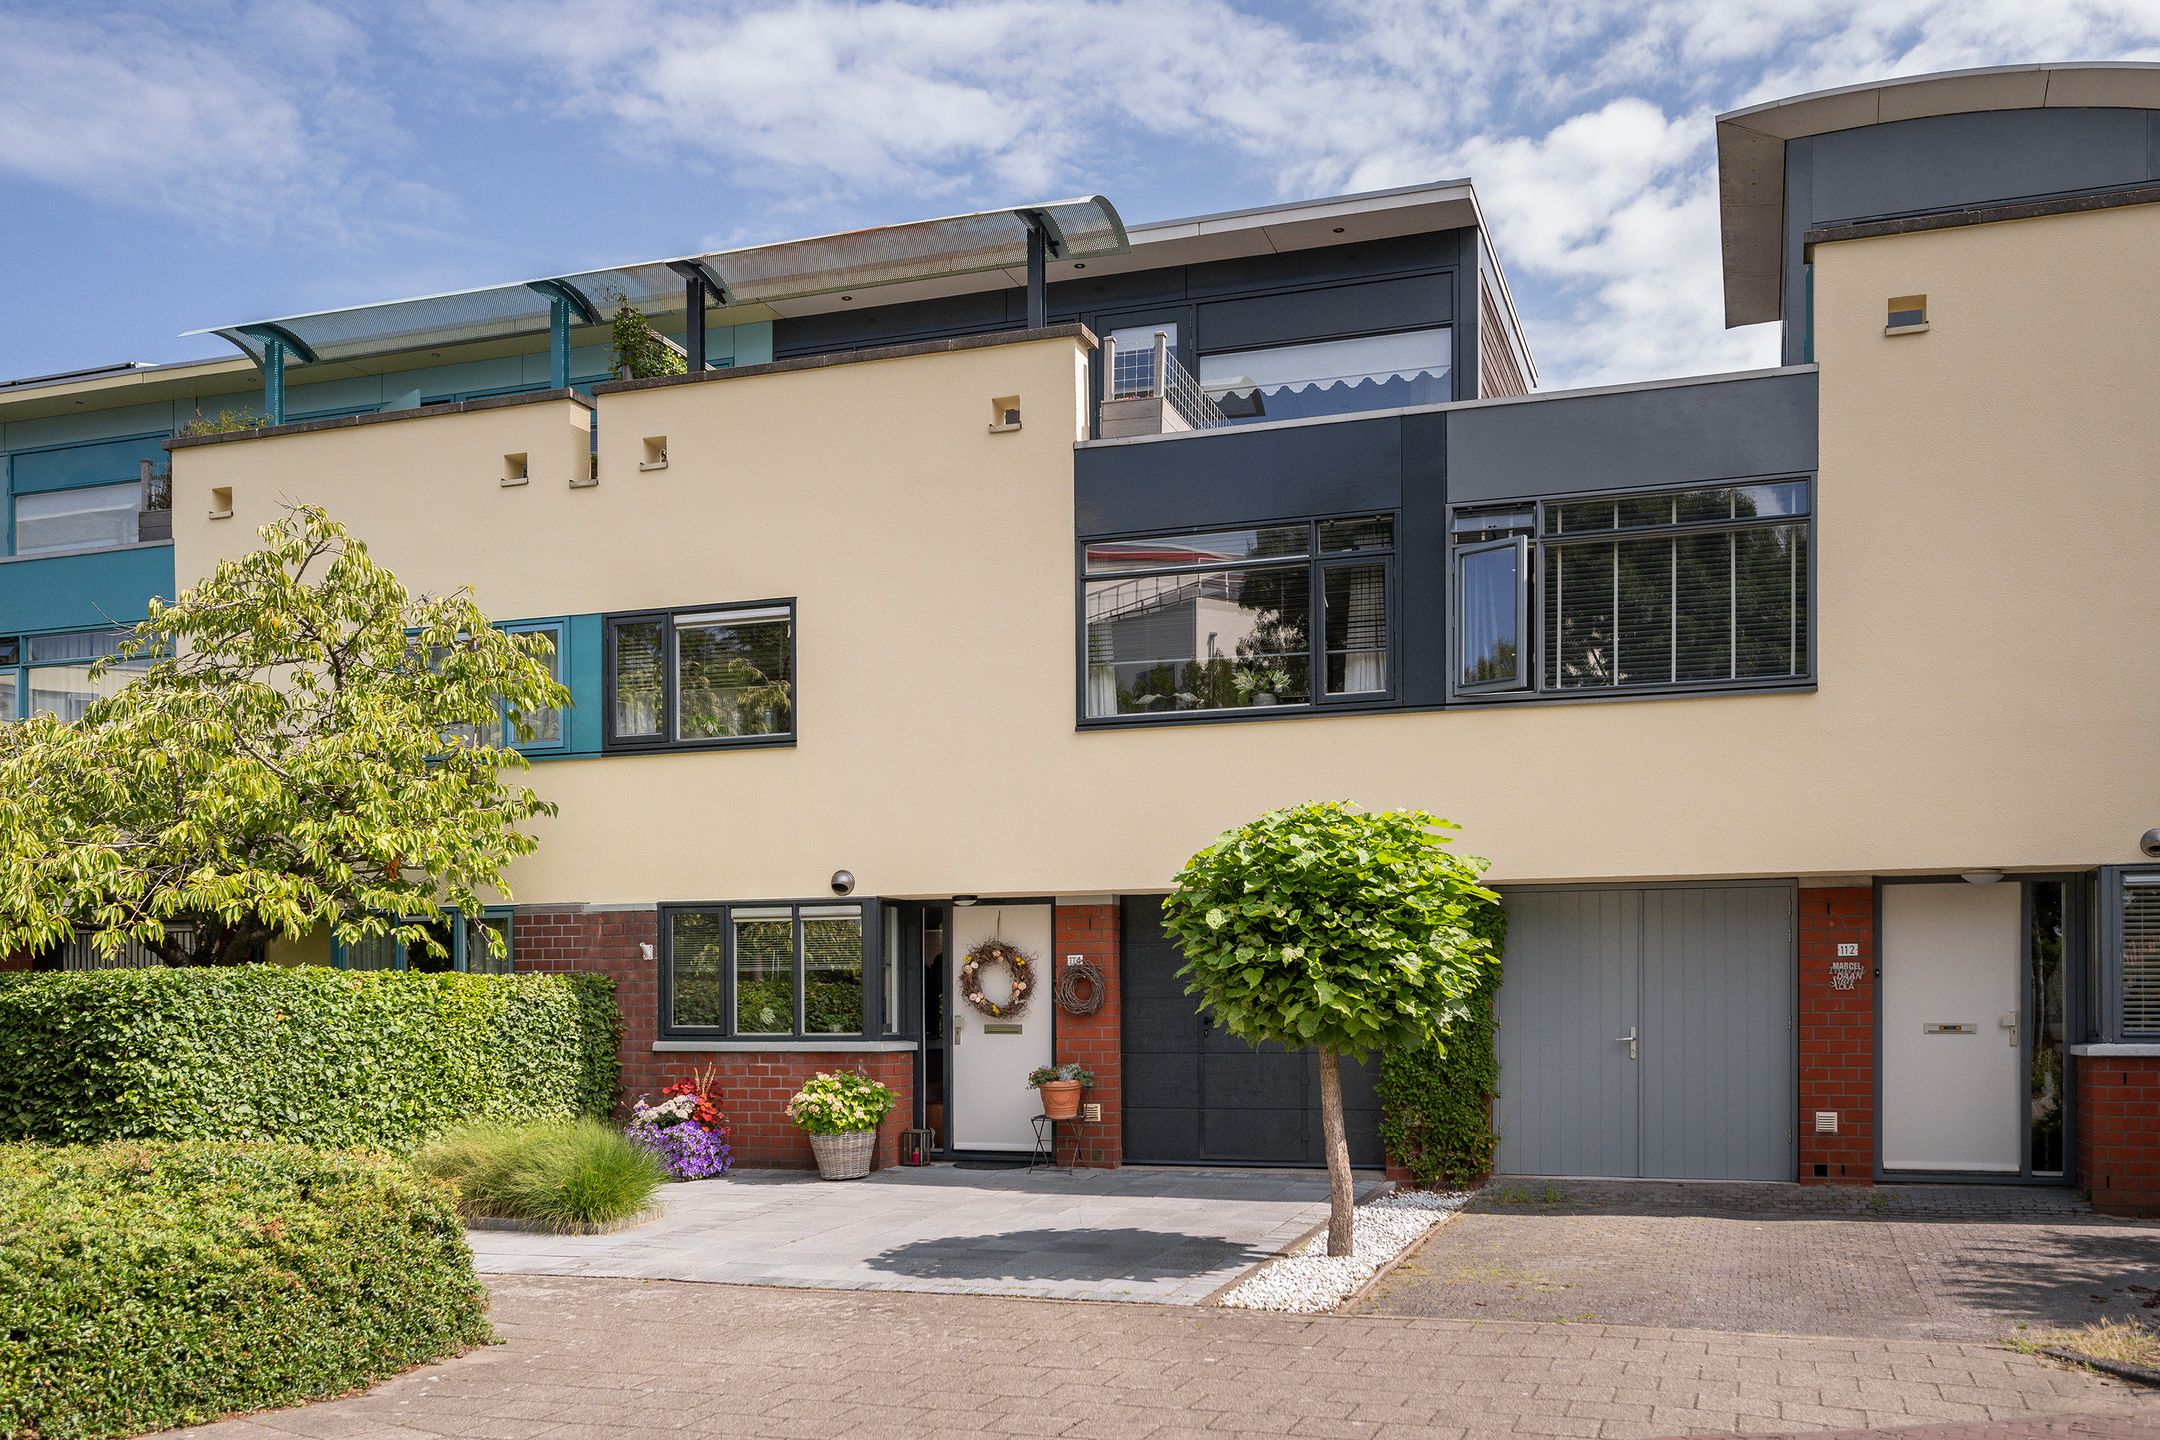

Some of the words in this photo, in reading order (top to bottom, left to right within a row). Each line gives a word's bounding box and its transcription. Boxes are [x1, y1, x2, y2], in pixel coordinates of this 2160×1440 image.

[1840, 945, 1855, 955] 112
[1832, 961, 1862, 970] MARCEL
[1837, 972, 1863, 980] DAAN
